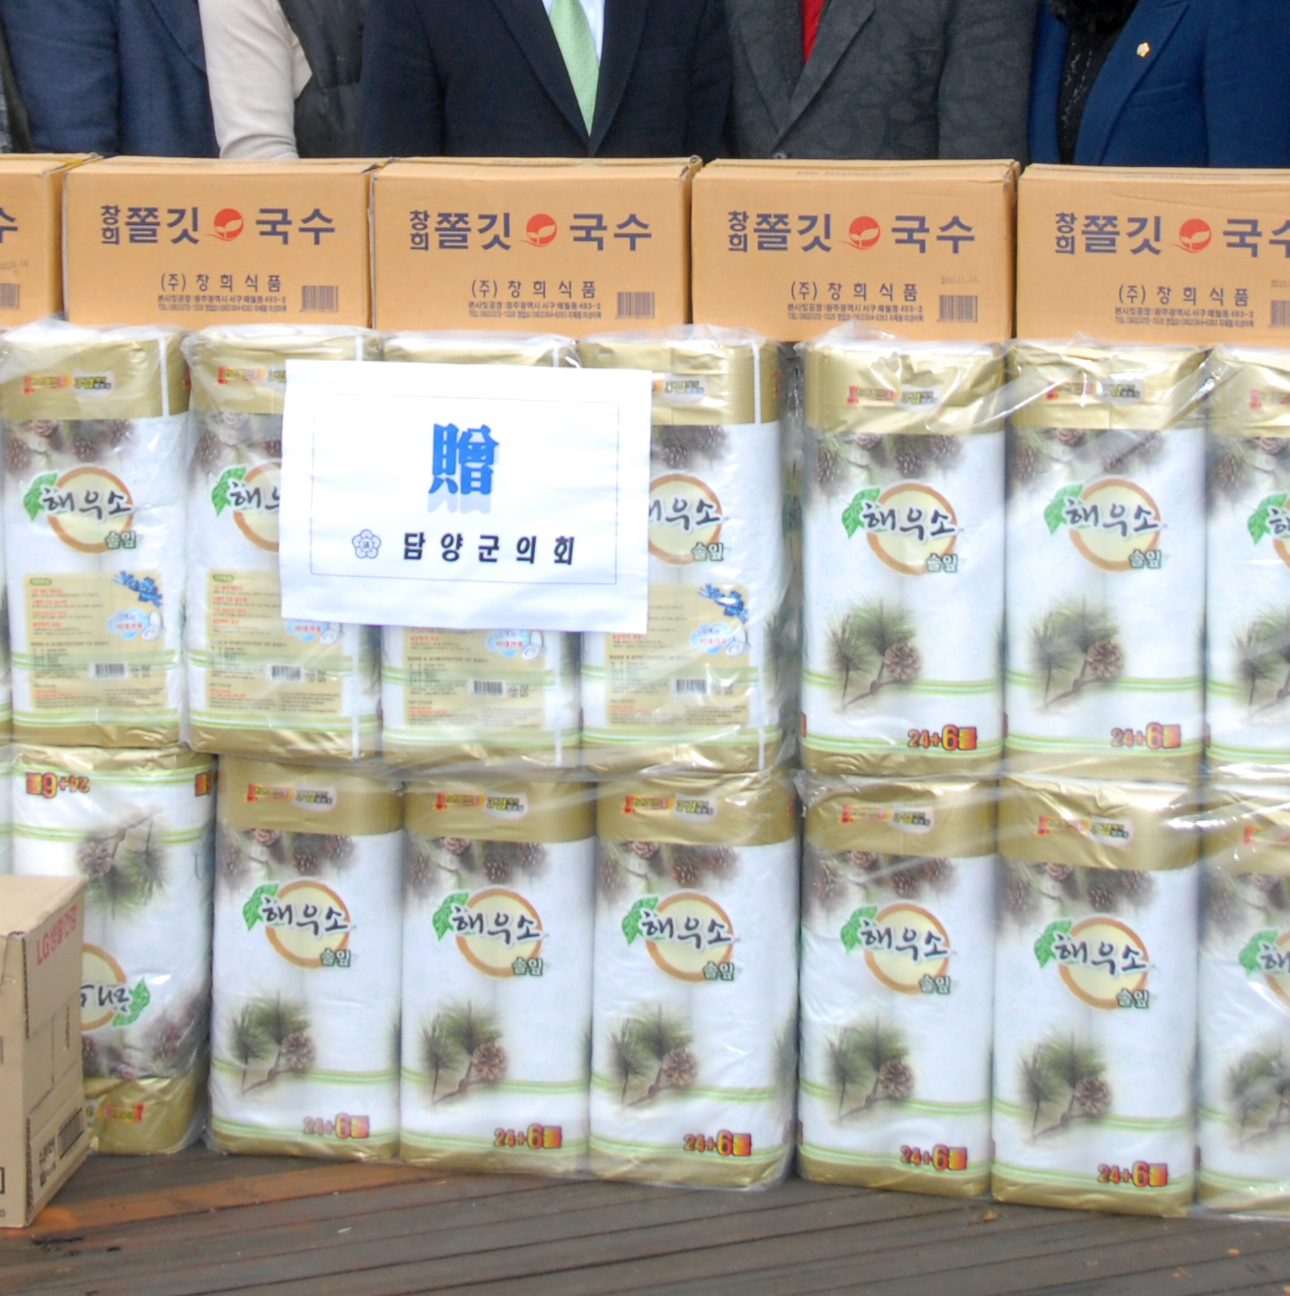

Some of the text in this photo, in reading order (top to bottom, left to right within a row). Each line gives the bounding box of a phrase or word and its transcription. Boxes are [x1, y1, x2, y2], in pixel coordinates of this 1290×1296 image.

[125, 207, 200, 246] 쫄깃
[255, 208, 336, 246] 국수
[434, 212, 512, 251] 쫄깃
[569, 213, 653, 252] 국수
[753, 212, 833, 254] 쫄깃
[891, 215, 976, 254] 국수
[1081, 215, 1162, 255] 쫄깃
[160, 273, 186, 292] (주)
[471, 279, 498, 299] (주)
[791, 281, 818, 301] (주)
[1118, 284, 1146, 305] (주)
[428, 423, 500, 496] 贈
[43, 487, 133, 520] 해우소
[863, 503, 958, 542] 해우소
[1065, 498, 1162, 536] 해우소
[261, 896, 350, 935] 해우소
[452, 906, 541, 944] 해우소
[641, 910, 733, 949] 해우소
[860, 919, 949, 961] 해우소
[1054, 934, 1148, 975] 해우소
